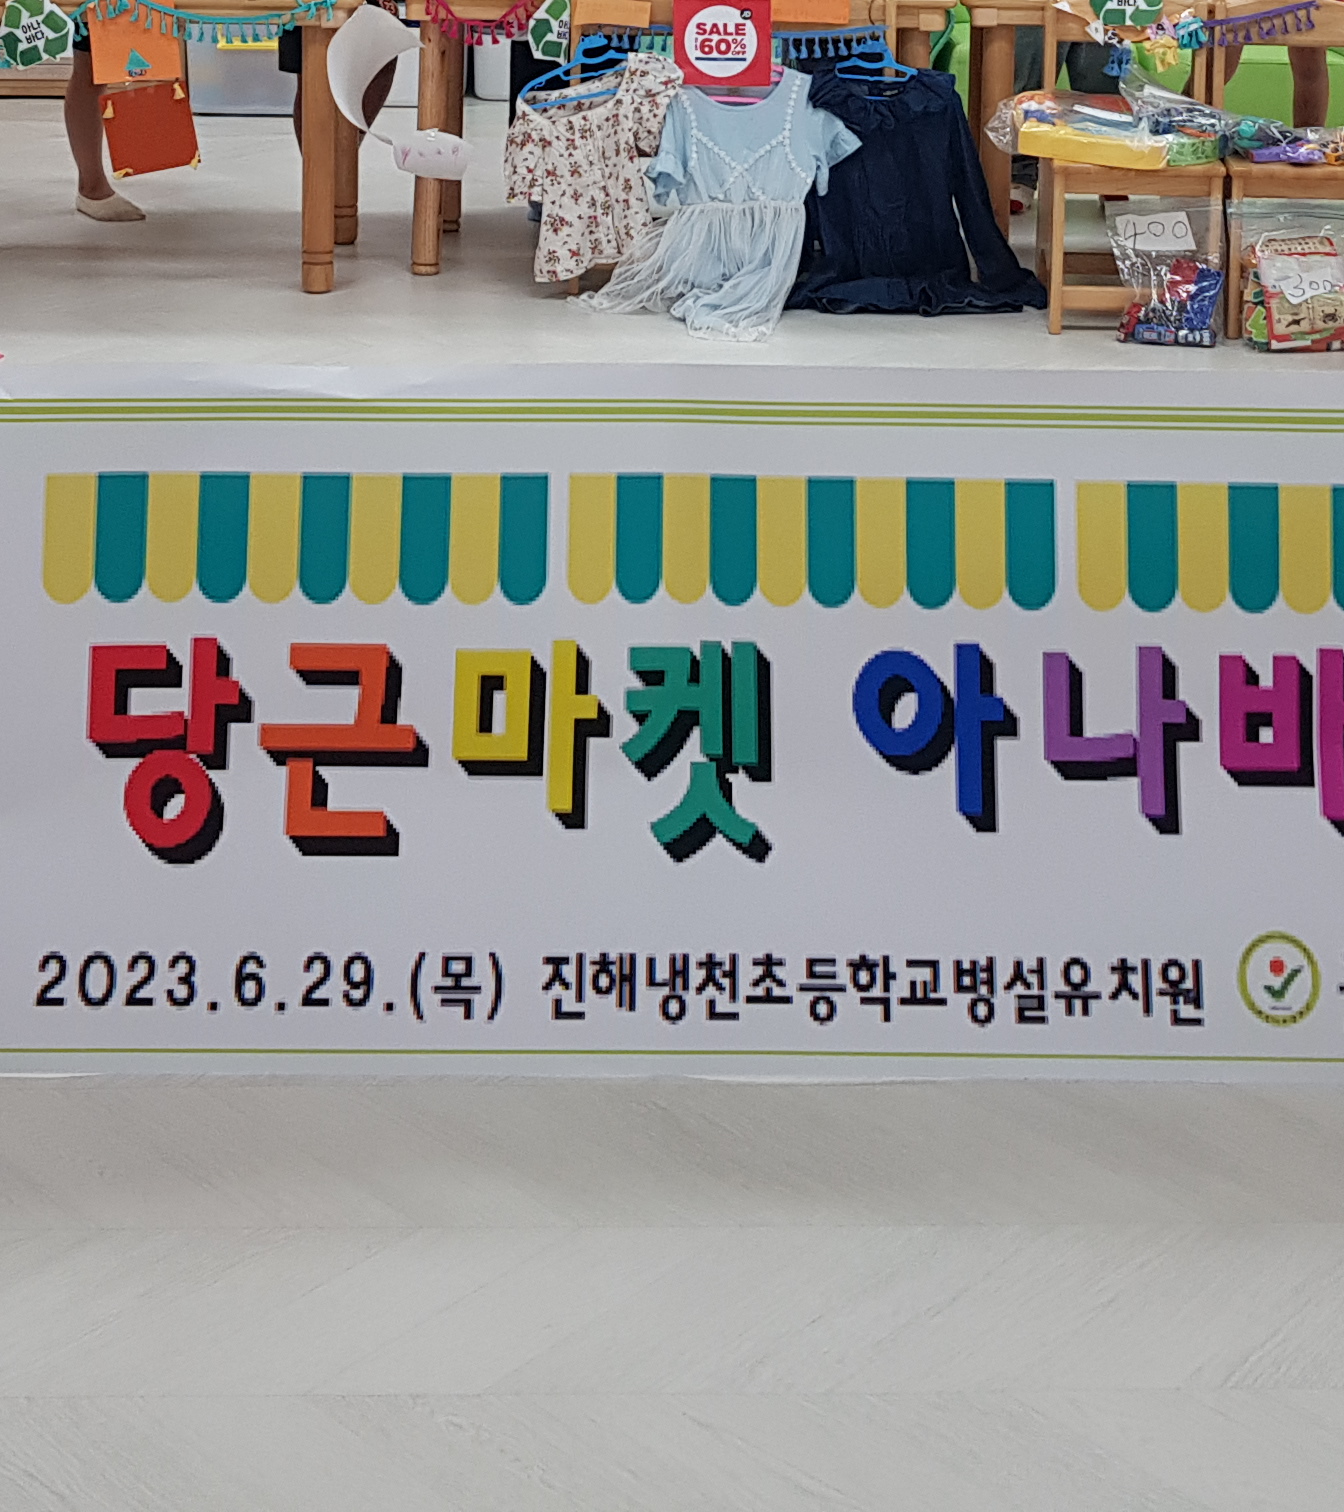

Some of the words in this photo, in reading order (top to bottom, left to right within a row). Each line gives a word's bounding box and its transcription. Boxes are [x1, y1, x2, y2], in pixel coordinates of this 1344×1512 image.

[21, 19, 41, 34] 아나
[24, 29, 45, 45] 바다
[695, 22, 747, 37] SALE
[699, 37, 747, 56] 60%
[1124, 218, 1190, 249] 400
[1288, 273, 1335, 298] 300
[86, 635, 774, 865] 당근마켓
[34, 951, 503, 1022] 2023.6.29.(목)
[541, 951, 1205, 1027] 진해냉천초등학교병설유치원
